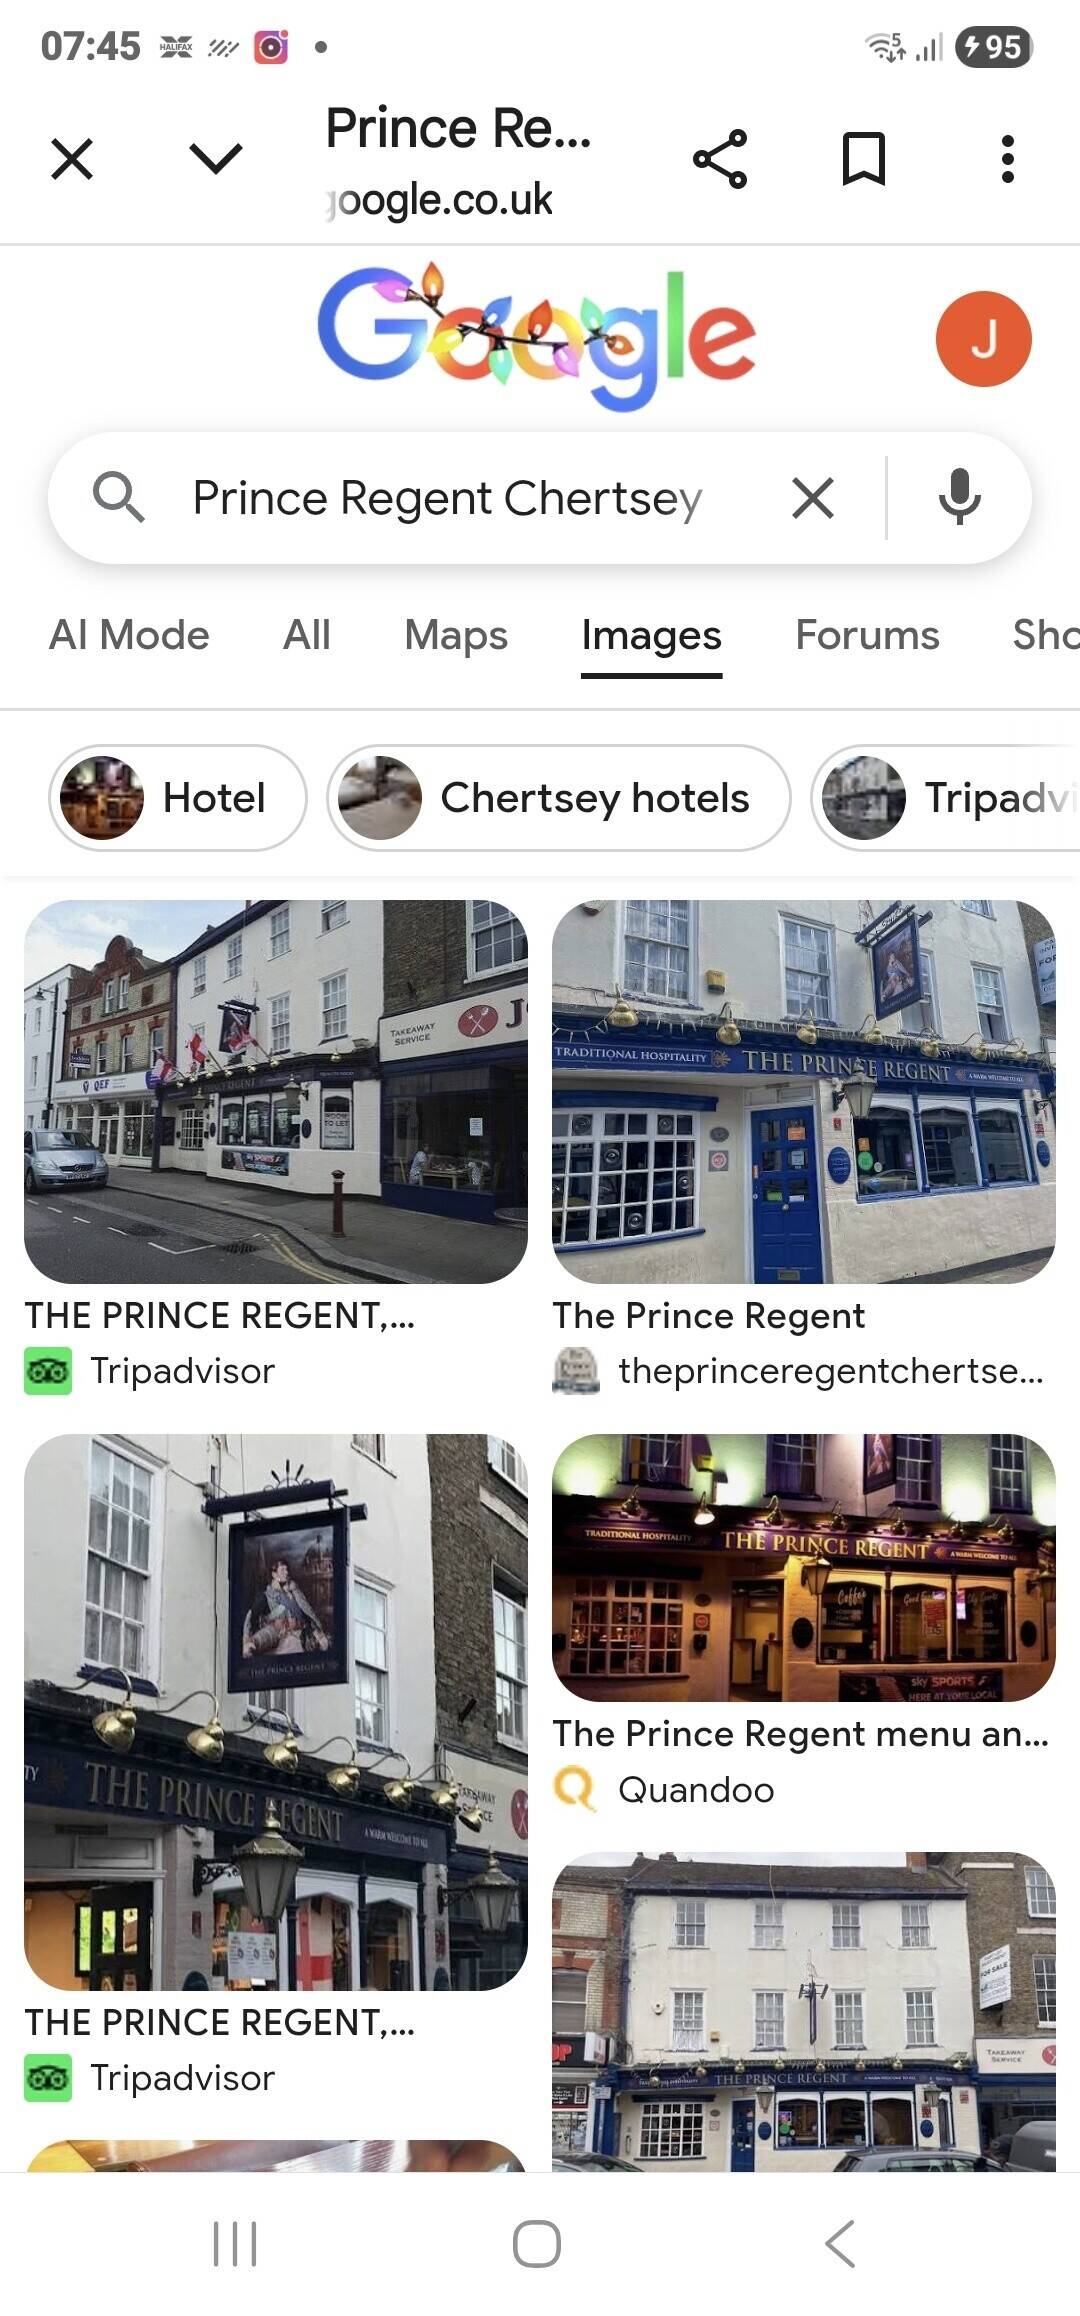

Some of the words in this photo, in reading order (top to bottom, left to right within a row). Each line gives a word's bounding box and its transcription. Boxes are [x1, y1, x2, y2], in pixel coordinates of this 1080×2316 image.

[41, 31, 140, 61] 07:45
[159, 43, 193, 51] HALIFAX
[985, 34, 1021, 60] 95
[327, 104, 477, 149] Prince
[494, 107, 591, 149] Re...
[318, 267, 756, 413] Google
[972, 321, 997, 359] J
[195, 480, 328, 516] Prince
[342, 480, 493, 525] Regent
[504, 480, 703, 525] Chertsey
[48, 618, 87, 650] AI
[101, 618, 210, 651] Mode
[282, 618, 330, 650] All
[406, 618, 508, 659] Maps
[583, 618, 722, 659] Images
[797, 618, 940, 651] Forums
[1013, 618, 1080, 651] Sho
[164, 781, 265, 814] Hotel
[441, 780, 622, 822] Chertsey
[632, 781, 750, 814] hotels
[389, 1022, 436, 1037] TAKEAWAY
[505, 998, 528, 1028] J
[394, 1033, 431, 1046] SERVICE
[554, 1047, 639, 1060] TRADITIONAL
[640, 1051, 707, 1063] HOSPITALITY
[742, 1050, 794, 1072] THE
[884, 1060, 950, 1082] REGENT
[93, 1079, 110, 1092] QEF
[24, 1301, 91, 1329] THE
[103, 1301, 230, 1330] PRINCE
[242, 1301, 415, 1334] REGENT,...
[552, 1301, 615, 1330] The
[627, 1300, 734, 1330] Prince
[746, 1301, 866, 1337] Regent
[90, 1356, 276, 1392] Tripadvisor
[618, 1356, 1043, 1392] theprinceregentchertse...
[584, 1529, 641, 1540] TRADITIONAL
[642, 1532, 693, 1543] HOSPITALITY
[721, 1531, 766, 1550] THE
[774, 1534, 849, 1555] PRINCE
[855, 1539, 930, 1560] REGENT
[838, 1587, 867, 1606] Coffee
[911, 1676, 928, 1688] sky
[932, 1676, 975, 1687] SPORTS
[552, 1719, 615, 1748] The
[627, 1718, 734, 1748] Prince
[746, 1719, 866, 1755] Regent
[877, 1726, 971, 1748] menu
[982, 1726, 1049, 1748] an...
[85, 1762, 150, 1811] THE
[158, 1776, 255, 1827] PRINCE
[618, 1775, 775, 1804] Quandoo
[992, 1961, 1008, 1973] SALE
[24, 2008, 91, 2036] THE
[103, 2007, 230, 2037] PRINCE
[242, 2008, 415, 2040] REGENT,...
[90, 2063, 276, 2099] Tripadvisor
[715, 2074, 741, 2086] THE
[745, 2073, 794, 2085] PRINCE
[797, 2072, 849, 2084] REGENT
